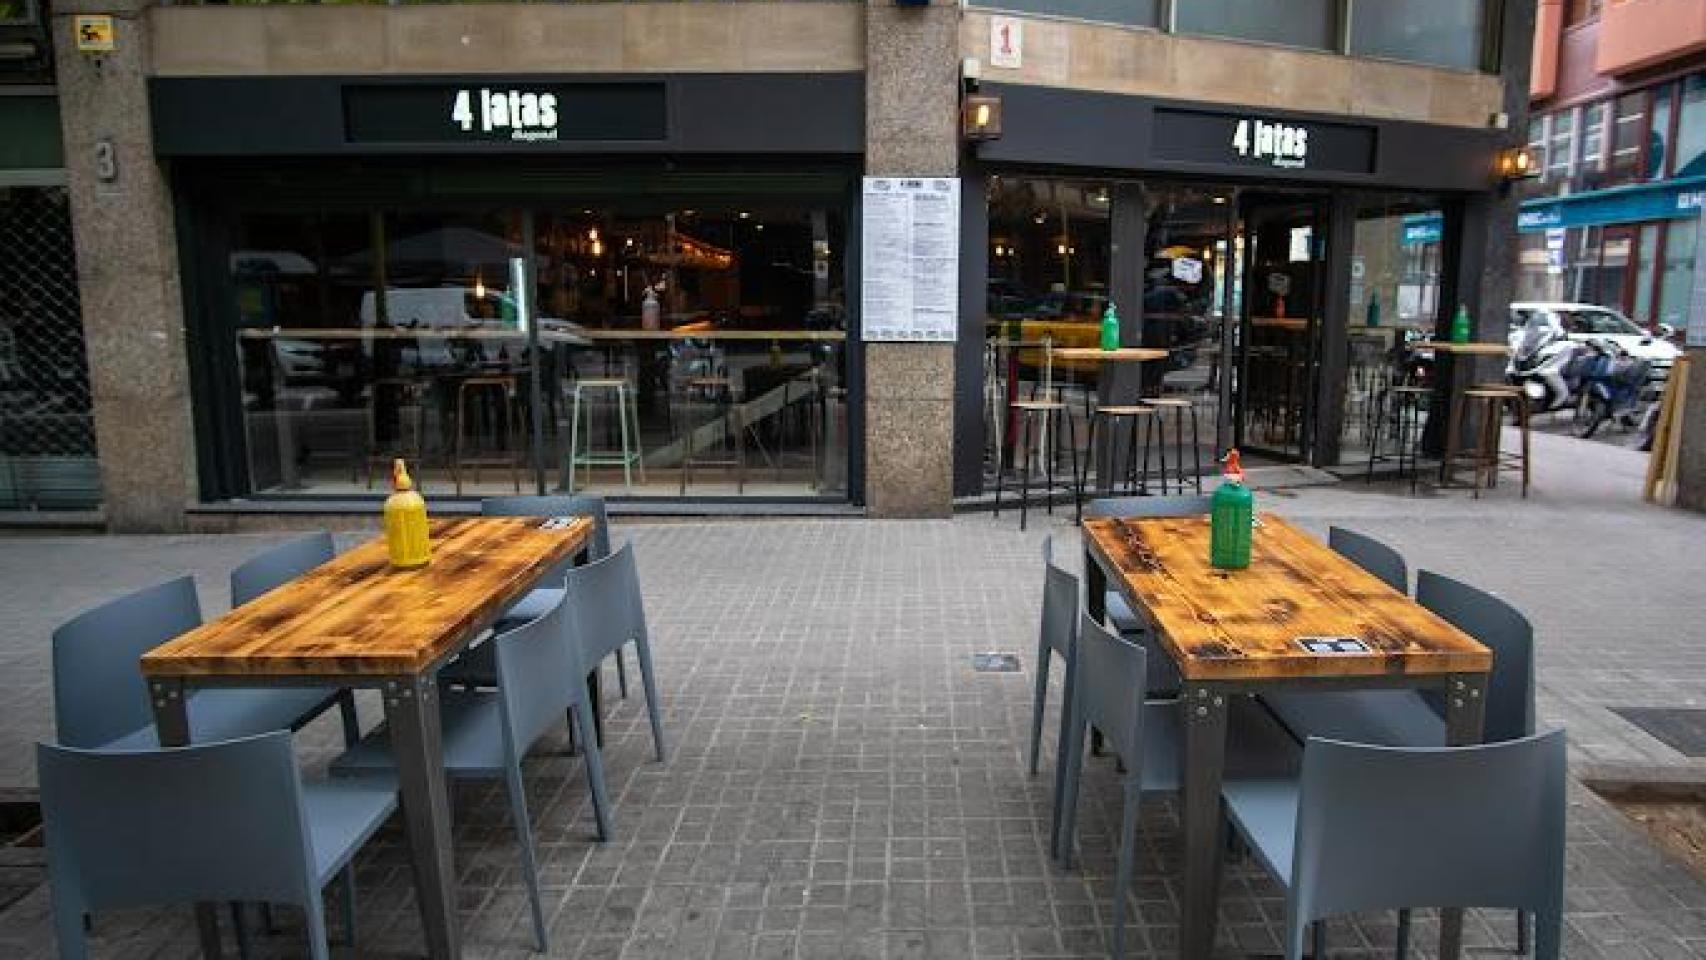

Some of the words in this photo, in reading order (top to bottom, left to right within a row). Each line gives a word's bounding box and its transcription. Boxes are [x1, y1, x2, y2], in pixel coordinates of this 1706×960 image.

[1000, 23, 1012, 55] 1
[452, 90, 473, 130] 4
[481, 88, 558, 129] latas
[1232, 119, 1250, 156] 4
[1254, 119, 1308, 158] latas
[96, 141, 115, 181] 3
